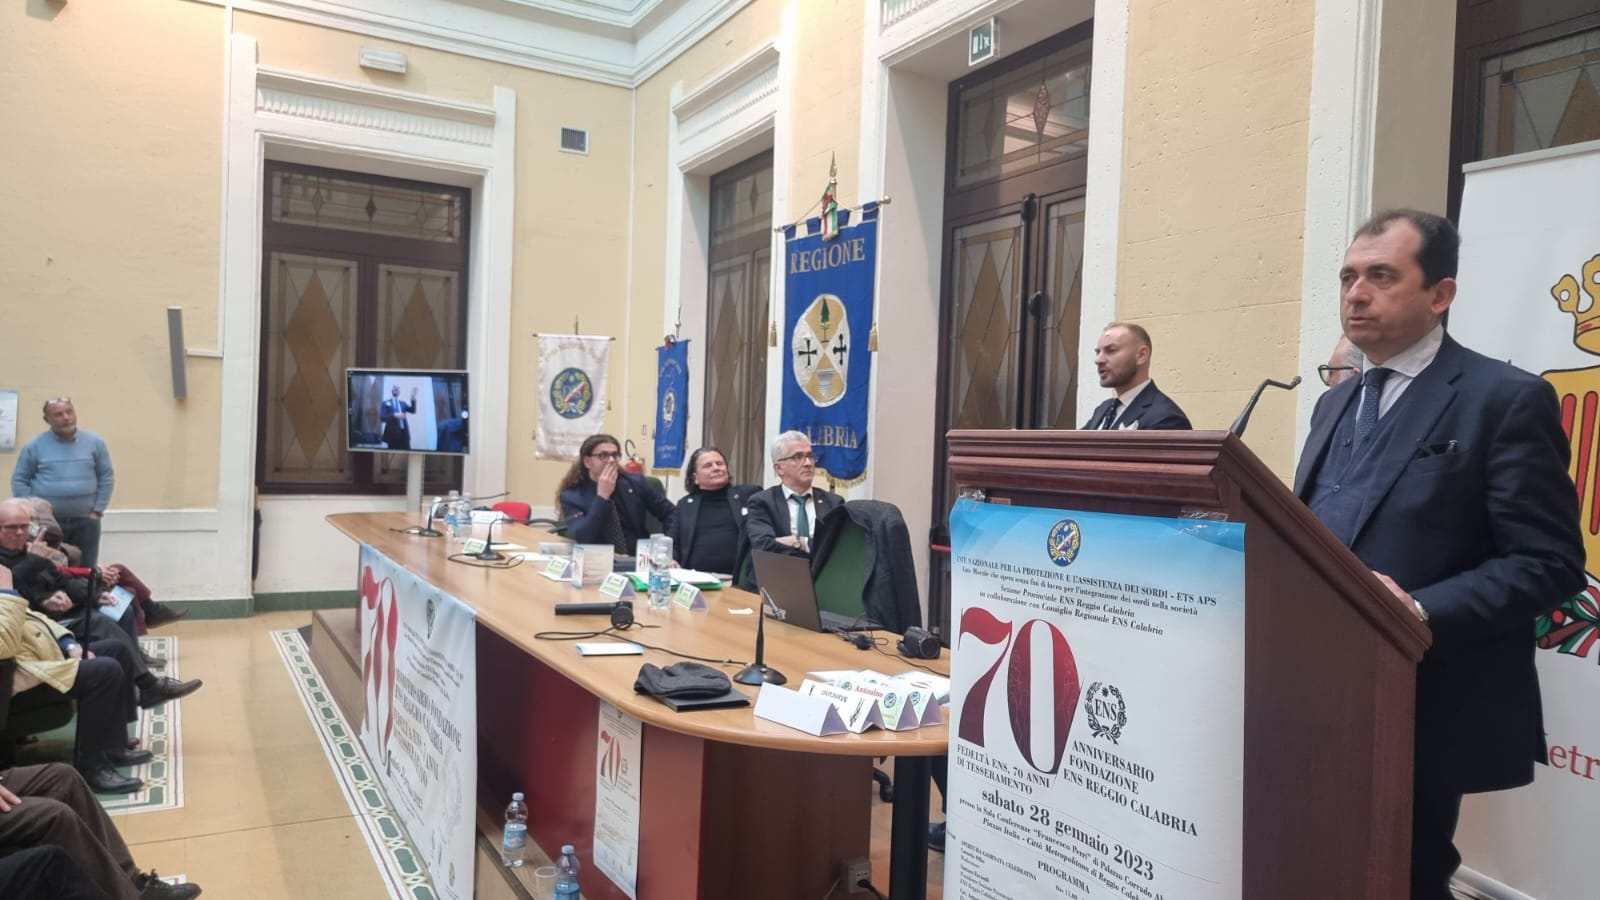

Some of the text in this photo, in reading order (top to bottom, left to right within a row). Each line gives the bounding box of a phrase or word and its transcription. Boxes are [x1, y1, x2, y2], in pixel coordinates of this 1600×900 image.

[790, 238, 864, 274] REGIONE
[799, 424, 858, 449] LABRIA
[967, 557, 999, 570] NAZIONALE
[1000, 563, 1012, 572] PER
[1013, 566, 1021, 574] LA
[1022, 567, 1065, 581] PROTEZIONE
[1066, 574, 1072, 582] E
[1124, 584, 1140, 594] DEI
[1141, 586, 1168, 599] SORDI
[1177, 592, 1194, 603] ETS
[1197, 595, 1217, 607] APS
[990, 571, 999, 579] che
[1000, 574, 1014, 582] opera
[1040, 580, 1046, 588] di
[1047, 581, 1063, 591] lucro
[1063, 585, 1074, 594] per
[1120, 593, 1131, 603] dei
[1132, 597, 1150, 607] sordi
[1151, 600, 1169, 610] nella
[1170, 604, 1198, 615] società
[1000, 585, 1135, 618] Sezione Provinciale ENS Reggio Calabria
[986, 592, 1027, 607] collaborazione
[1029, 601, 1040, 609] con
[1041, 603, 1072, 616] Consiglio
[1074, 608, 1110, 624] Regionale
[1111, 616, 1128, 628] ENS
[1130, 620, 1164, 636] Calabria
[957, 606, 1080, 774] 70
[1094, 698, 1117, 722] ENS
[601, 730, 622, 788] 70
[957, 743, 1050, 788] FEDELTÀ ENS, 70 ANNI
[957, 756, 1033, 795] DI TESSERAMENTO
[1069, 754, 1139, 795] FONDAZIONE
[1072, 740, 1154, 783] ANNIVERSARIO
[1549, 743, 1600, 781] etr
[1063, 768, 1198, 837] ENS REGGIO CALABRIA
[959, 797, 975, 810] presso
[976, 804, 982, 813] la
[983, 807, 996, 819] Sala
[996, 812, 1032, 833] Conferenze
[1092, 857, 1100, 867] di
[1100, 860, 1123, 881] Palazzo
[1124, 875, 1152, 898] Corrado
[982, 789, 1154, 881] sabato 28 gennaio 2023
[982, 817, 1002, 832] Piazza
[1004, 826, 1021, 841] Italia
[1026, 837, 1043, 850] Città
[1045, 844, 1090, 873] Metropolitana
[1090, 868, 1098, 878] di
[1098, 870, 1120, 891] Reggio
[982, 850, 1005, 866] GIORNATA
[1005, 861, 1037, 880] CELEBRATIVA
[1038, 860, 1090, 895] PROGRAMMA
